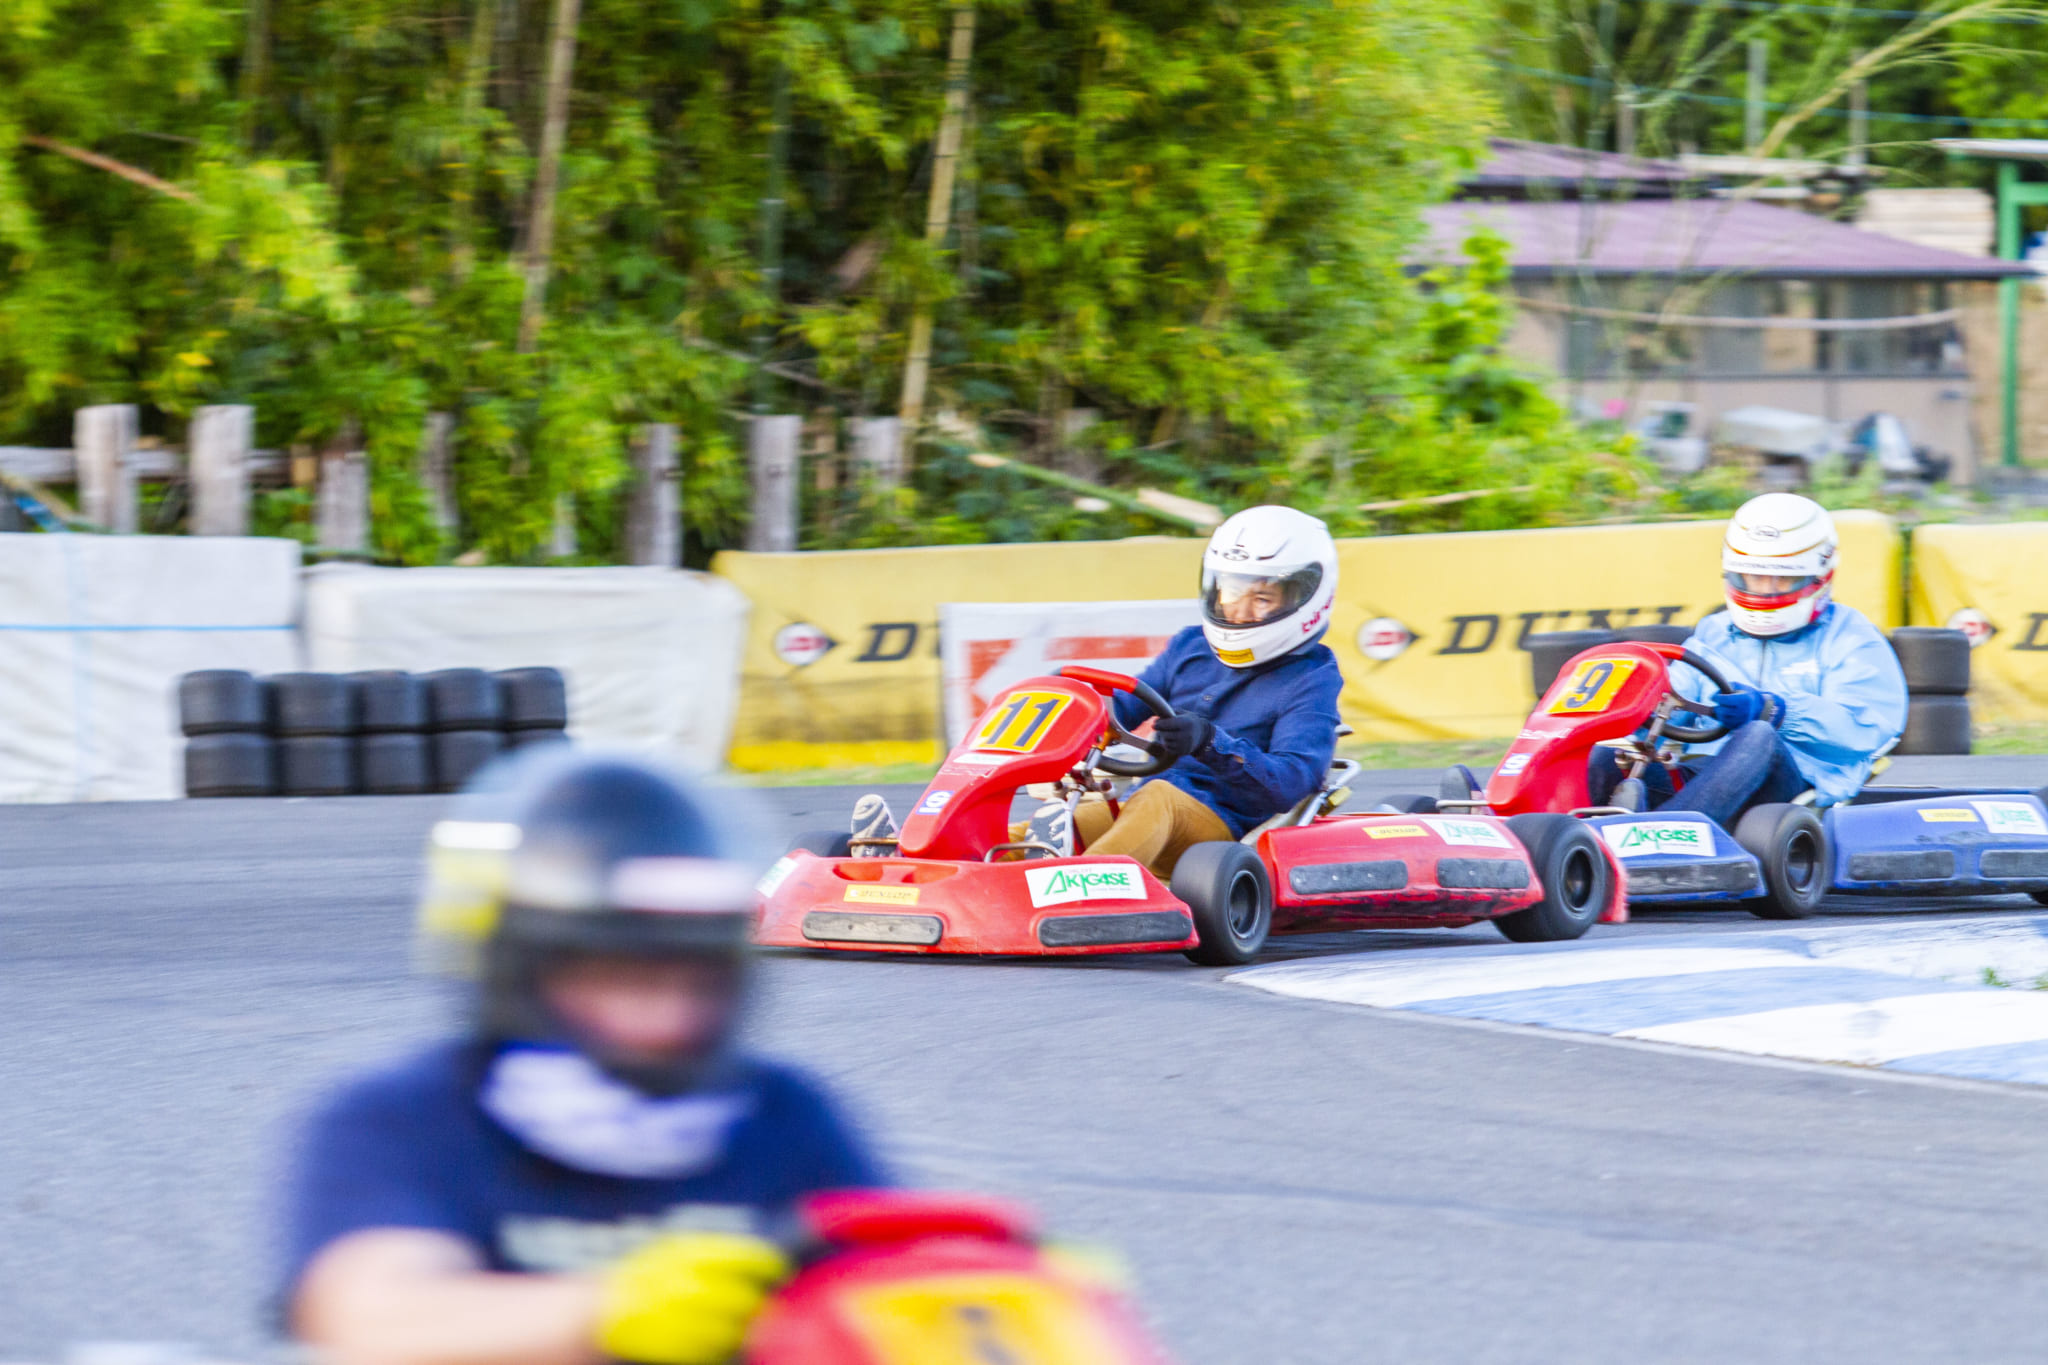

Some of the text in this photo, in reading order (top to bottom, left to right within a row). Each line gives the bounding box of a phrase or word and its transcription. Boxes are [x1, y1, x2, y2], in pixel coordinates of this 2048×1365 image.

[851, 622, 942, 663] D
[1566, 662, 1614, 708] 9
[985, 695, 1061, 747] 11
[1044, 870, 1131, 897] AKIGASE
